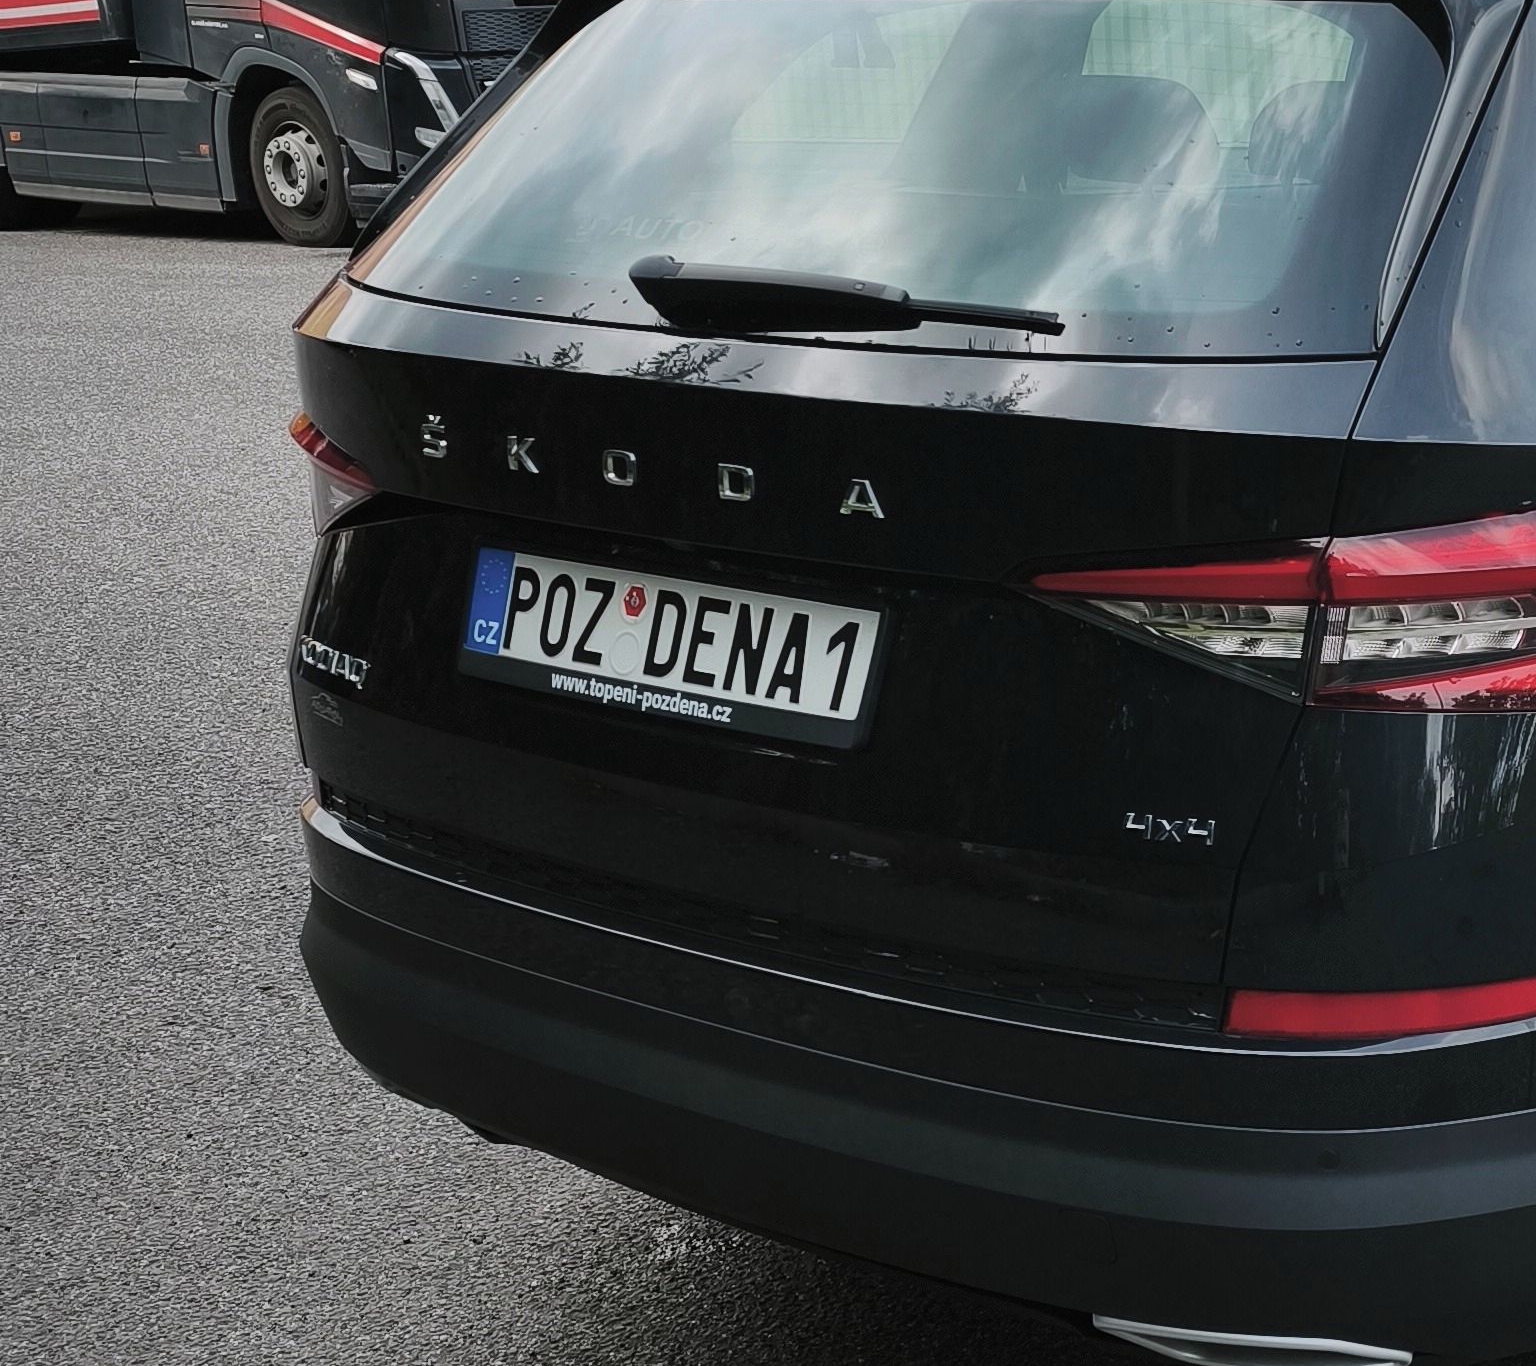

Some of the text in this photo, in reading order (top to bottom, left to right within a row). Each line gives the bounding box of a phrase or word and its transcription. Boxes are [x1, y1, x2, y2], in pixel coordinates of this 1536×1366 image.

[420, 414, 886, 520] ŠKODA
[473, 618, 499, 645] CZ
[502, 565, 617, 667] POZ
[551, 671, 733, 724] www.topeni-pozdena.cz
